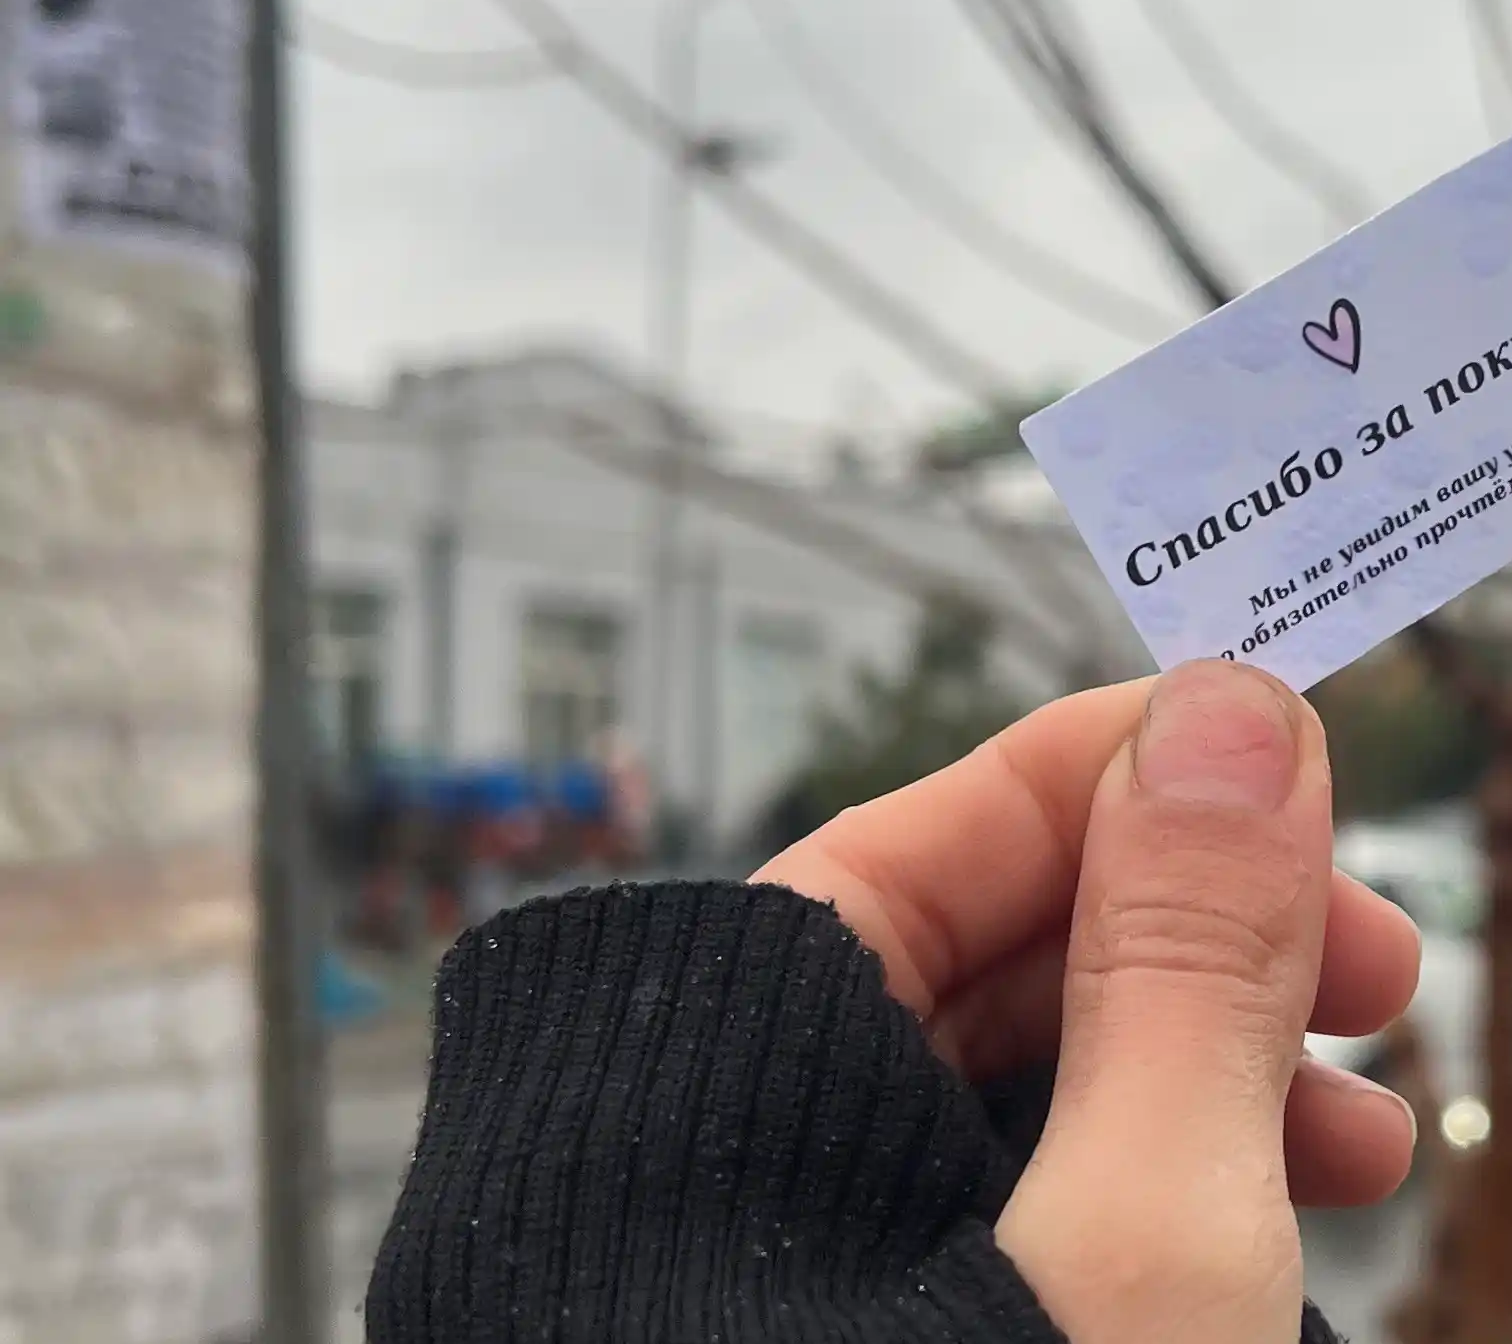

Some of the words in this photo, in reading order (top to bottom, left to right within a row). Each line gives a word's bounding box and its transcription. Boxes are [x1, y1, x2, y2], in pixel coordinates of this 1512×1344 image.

[1125, 447, 1344, 587] Спасибо
[1355, 403, 1415, 457] за
[1248, 578, 1299, 616] Мы
[1302, 557, 1334, 585] не
[1337, 498, 1432, 568] увидим
[1436, 456, 1499, 503] вашу
[1241, 545, 1409, 654] обязательно
